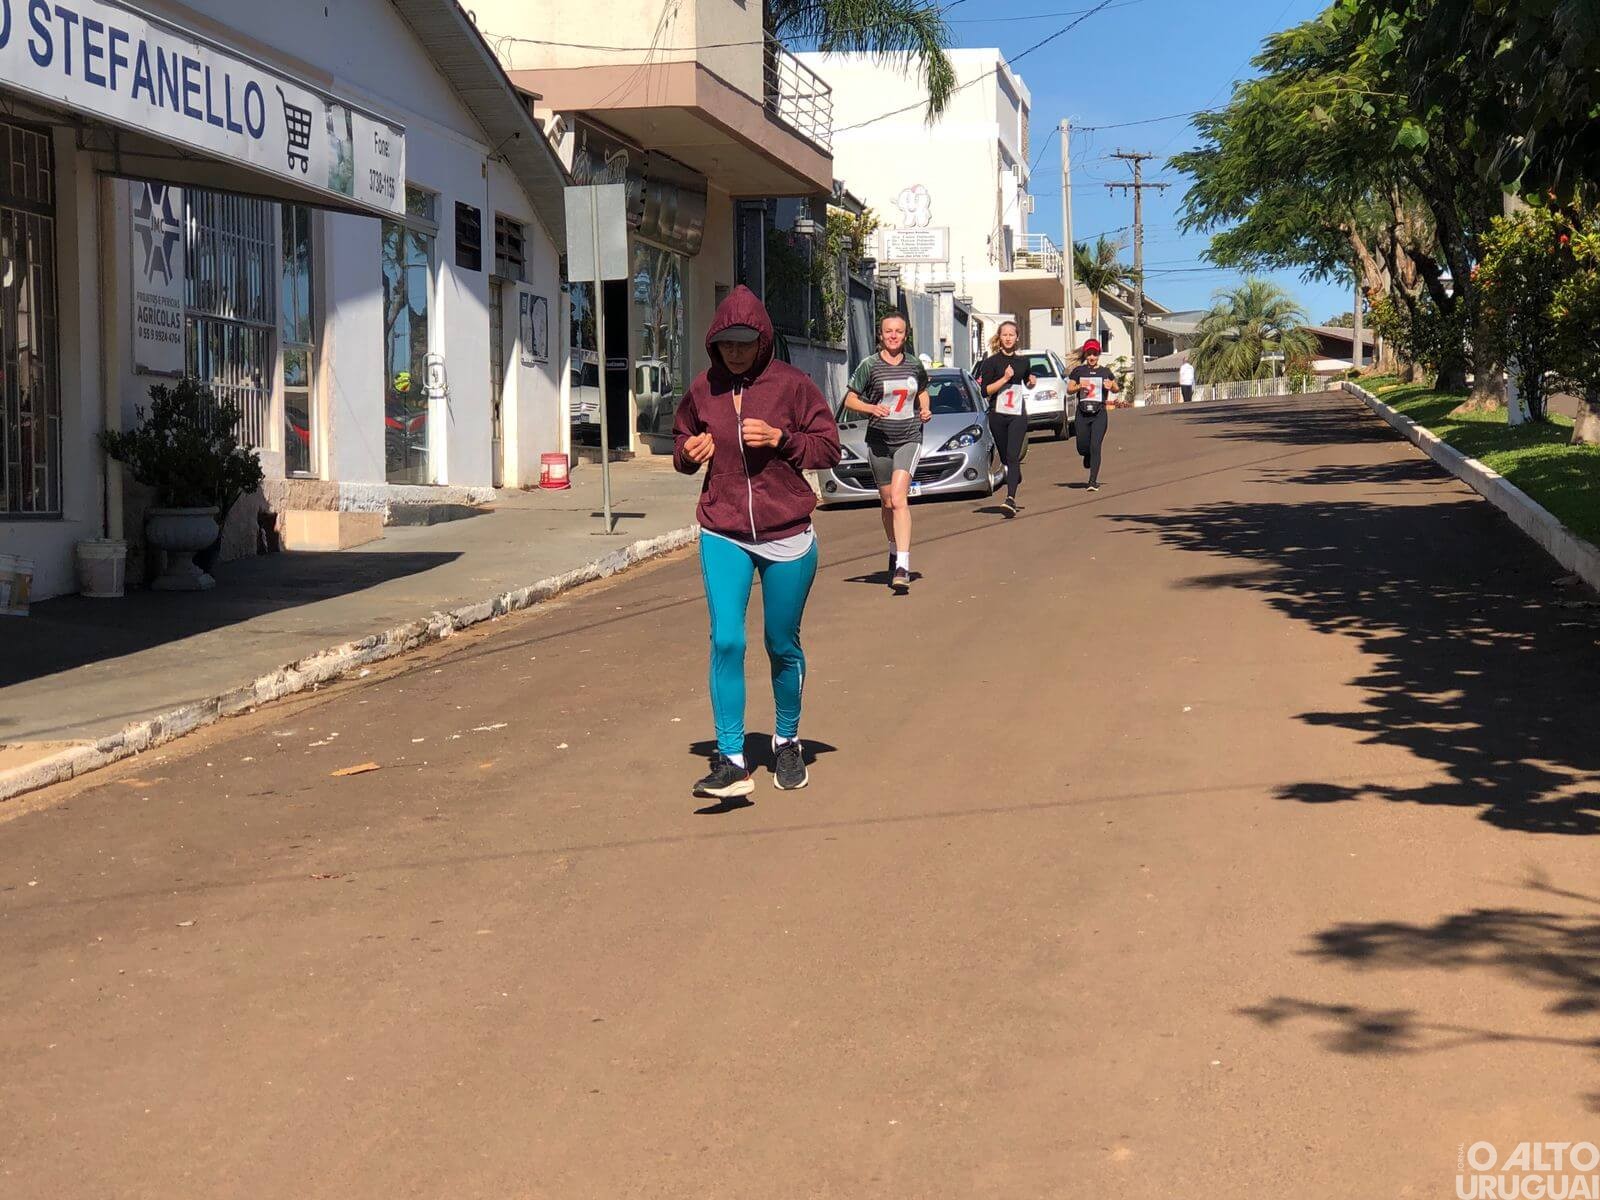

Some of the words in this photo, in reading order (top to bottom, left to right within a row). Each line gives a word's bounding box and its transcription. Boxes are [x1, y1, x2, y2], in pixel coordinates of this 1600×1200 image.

[28, 0, 265, 139] STEFANELLO
[892, 389, 908, 413] 7
[1004, 390, 1014, 409] 1
[1087, 383, 1096, 399] 2
